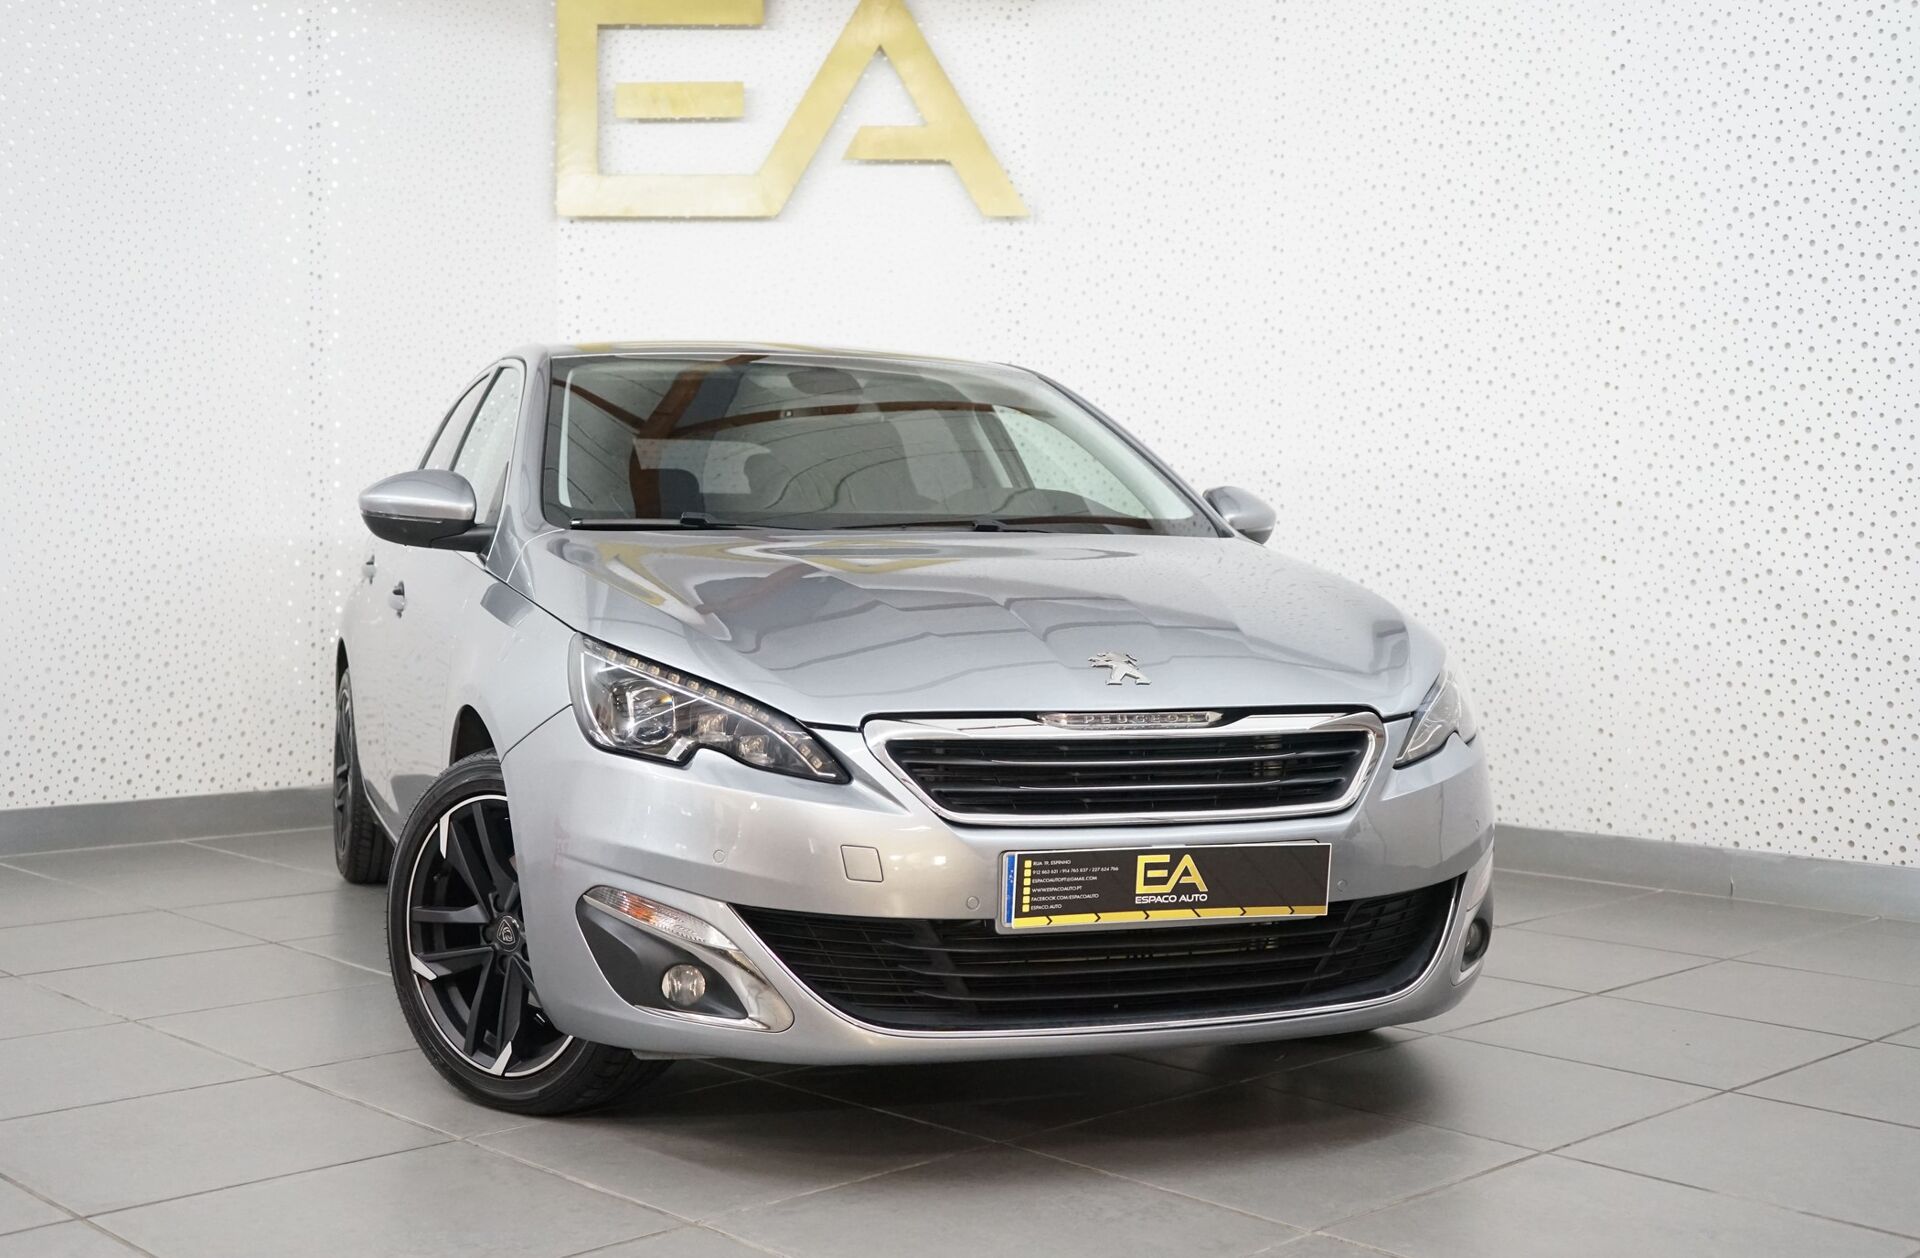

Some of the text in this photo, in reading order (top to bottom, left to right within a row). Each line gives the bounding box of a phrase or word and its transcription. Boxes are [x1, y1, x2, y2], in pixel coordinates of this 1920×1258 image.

[556, 0, 1030, 219] EA
[1084, 713, 1195, 724] PEUGEOT
[1135, 854, 1208, 894] EA
[1135, 893, 1208, 904] ESPACO AUTO
